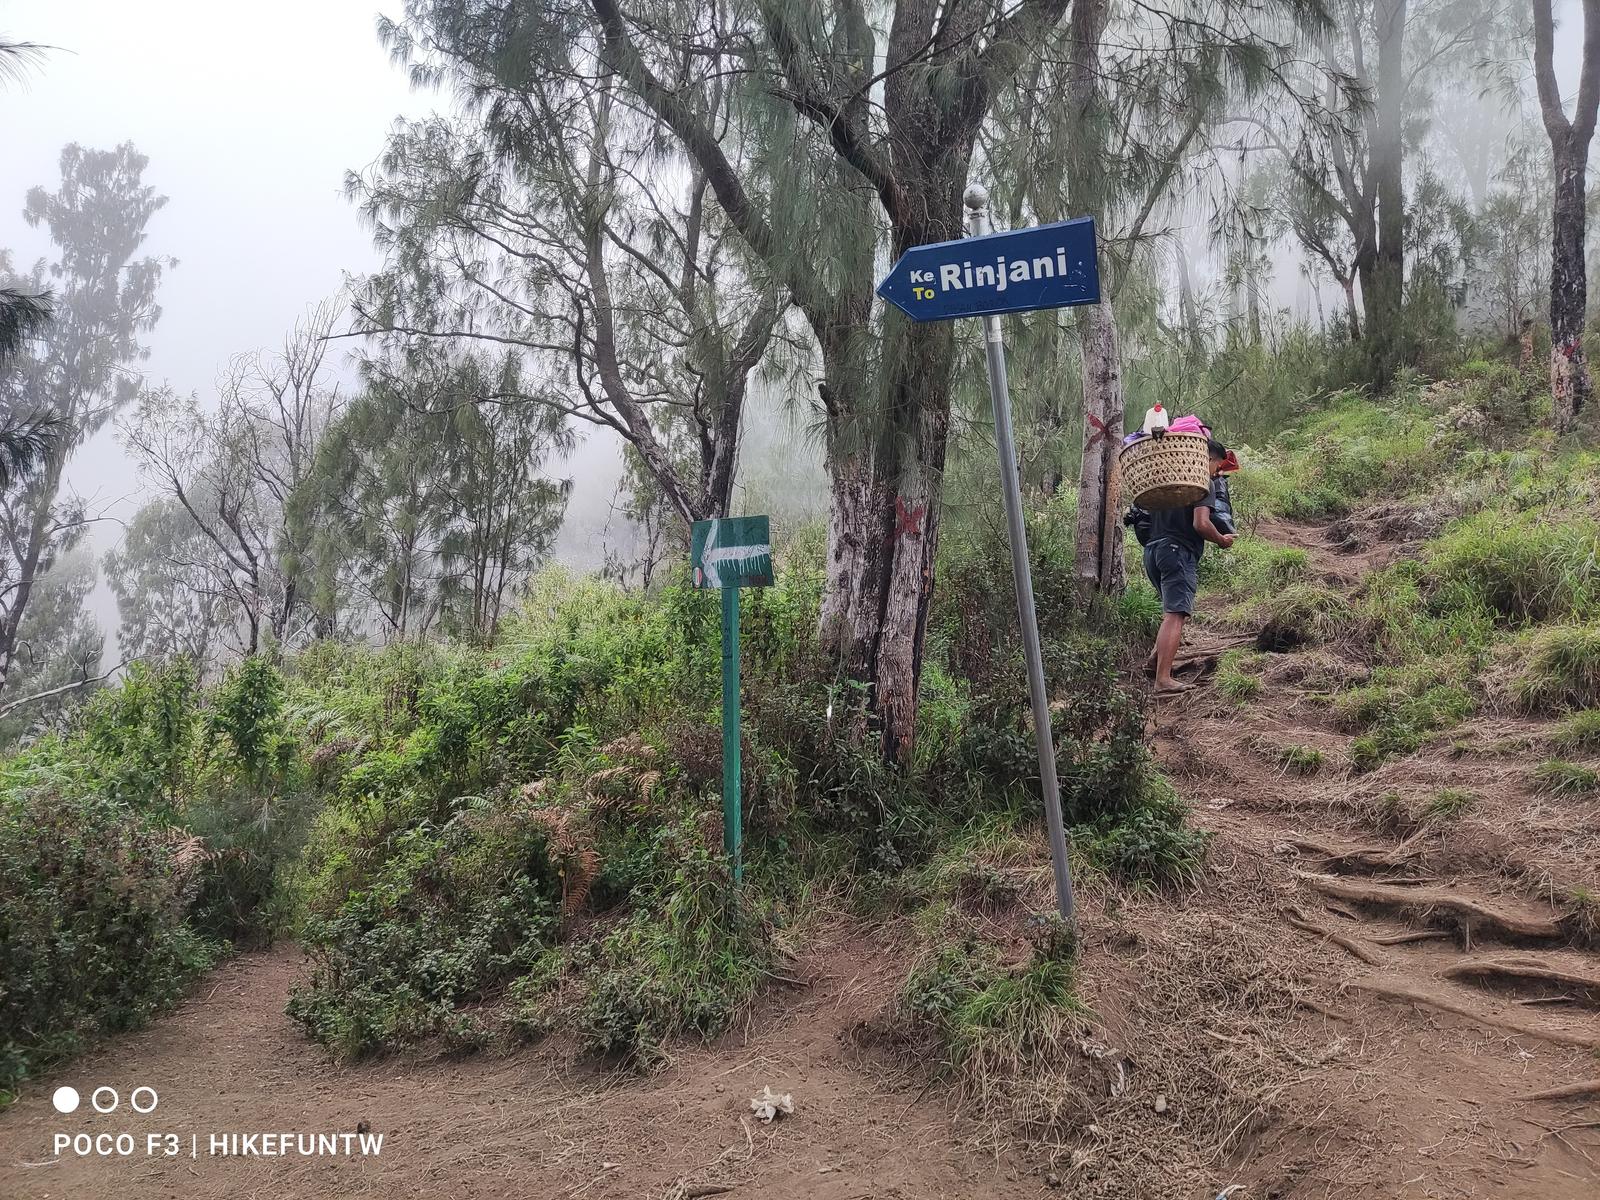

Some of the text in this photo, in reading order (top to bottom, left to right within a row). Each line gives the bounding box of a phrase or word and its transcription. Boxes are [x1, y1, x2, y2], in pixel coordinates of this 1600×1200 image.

[910, 247, 1068, 292] Ke Rinjani
[912, 286, 936, 300] To
